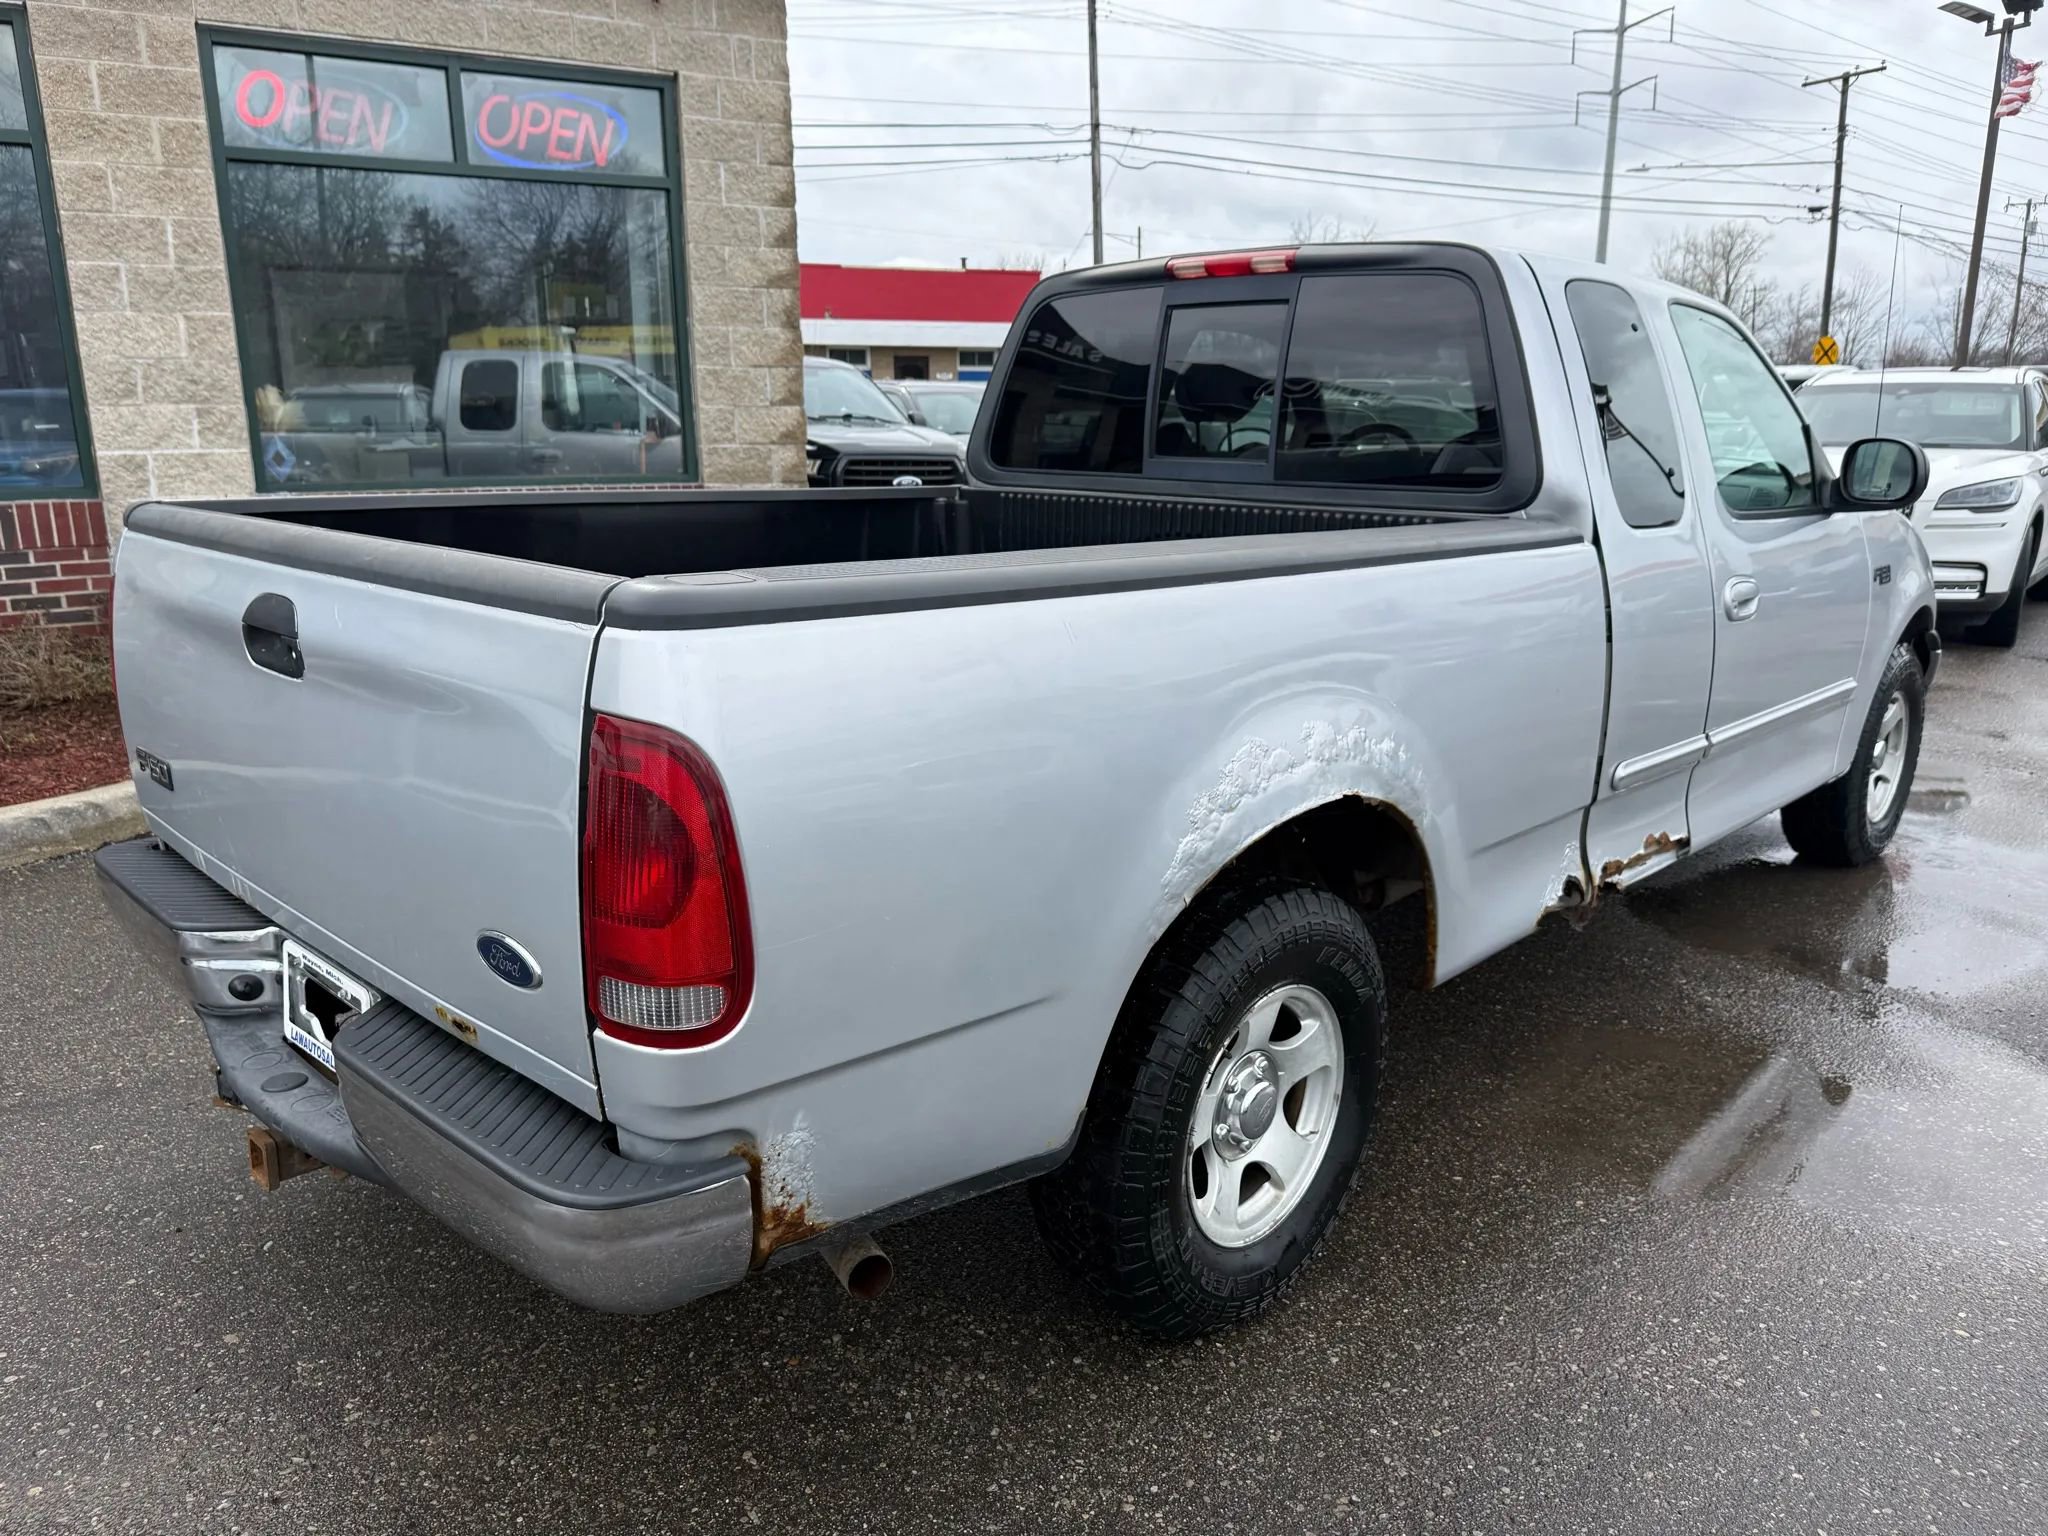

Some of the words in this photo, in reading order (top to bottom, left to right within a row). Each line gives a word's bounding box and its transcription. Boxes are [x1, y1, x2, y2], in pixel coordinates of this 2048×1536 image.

[236, 70, 392, 152] OPEN
[478, 94, 615, 167] OPEN
[1316, 946, 1373, 1004] KENDA
